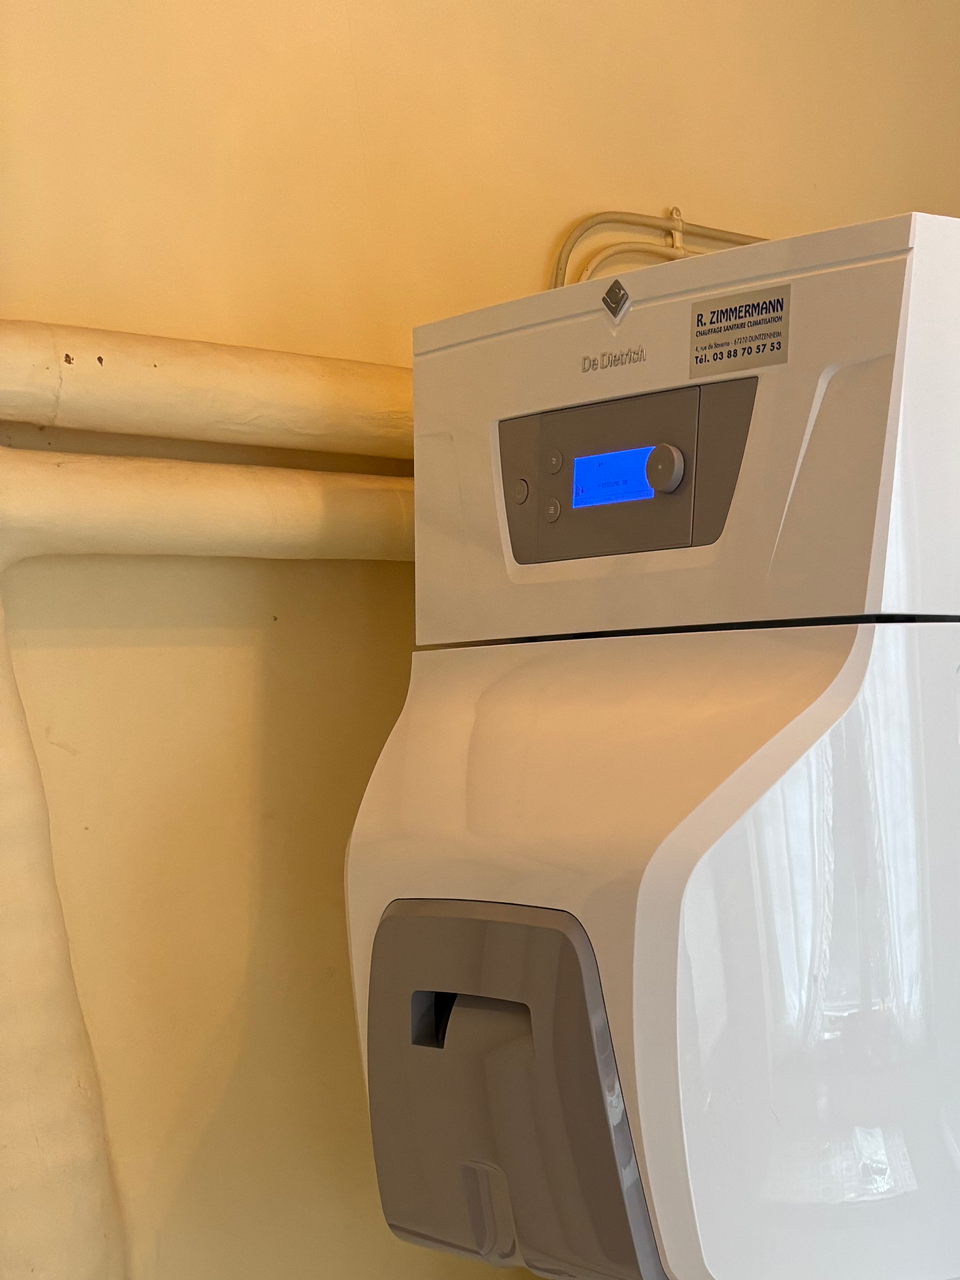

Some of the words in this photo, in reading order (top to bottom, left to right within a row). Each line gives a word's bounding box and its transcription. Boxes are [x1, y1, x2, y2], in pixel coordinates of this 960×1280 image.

[696, 313, 706, 328] R.
[709, 298, 784, 325] ZIMMERMANN
[695, 326, 722, 338] CHAUFFAGE
[723, 322, 746, 333] SANITAIRE
[746, 315, 783, 328] CLIMATISATION
[582, 355, 599, 373] De
[600, 344, 646, 370] Dietrich
[695, 353, 710, 365] Tél.
[712, 351, 724, 362] 03
[726, 349, 738, 359] 88
[741, 346, 752, 357] 70
[755, 343, 767, 354] 57
[769, 341, 782, 352] 53
